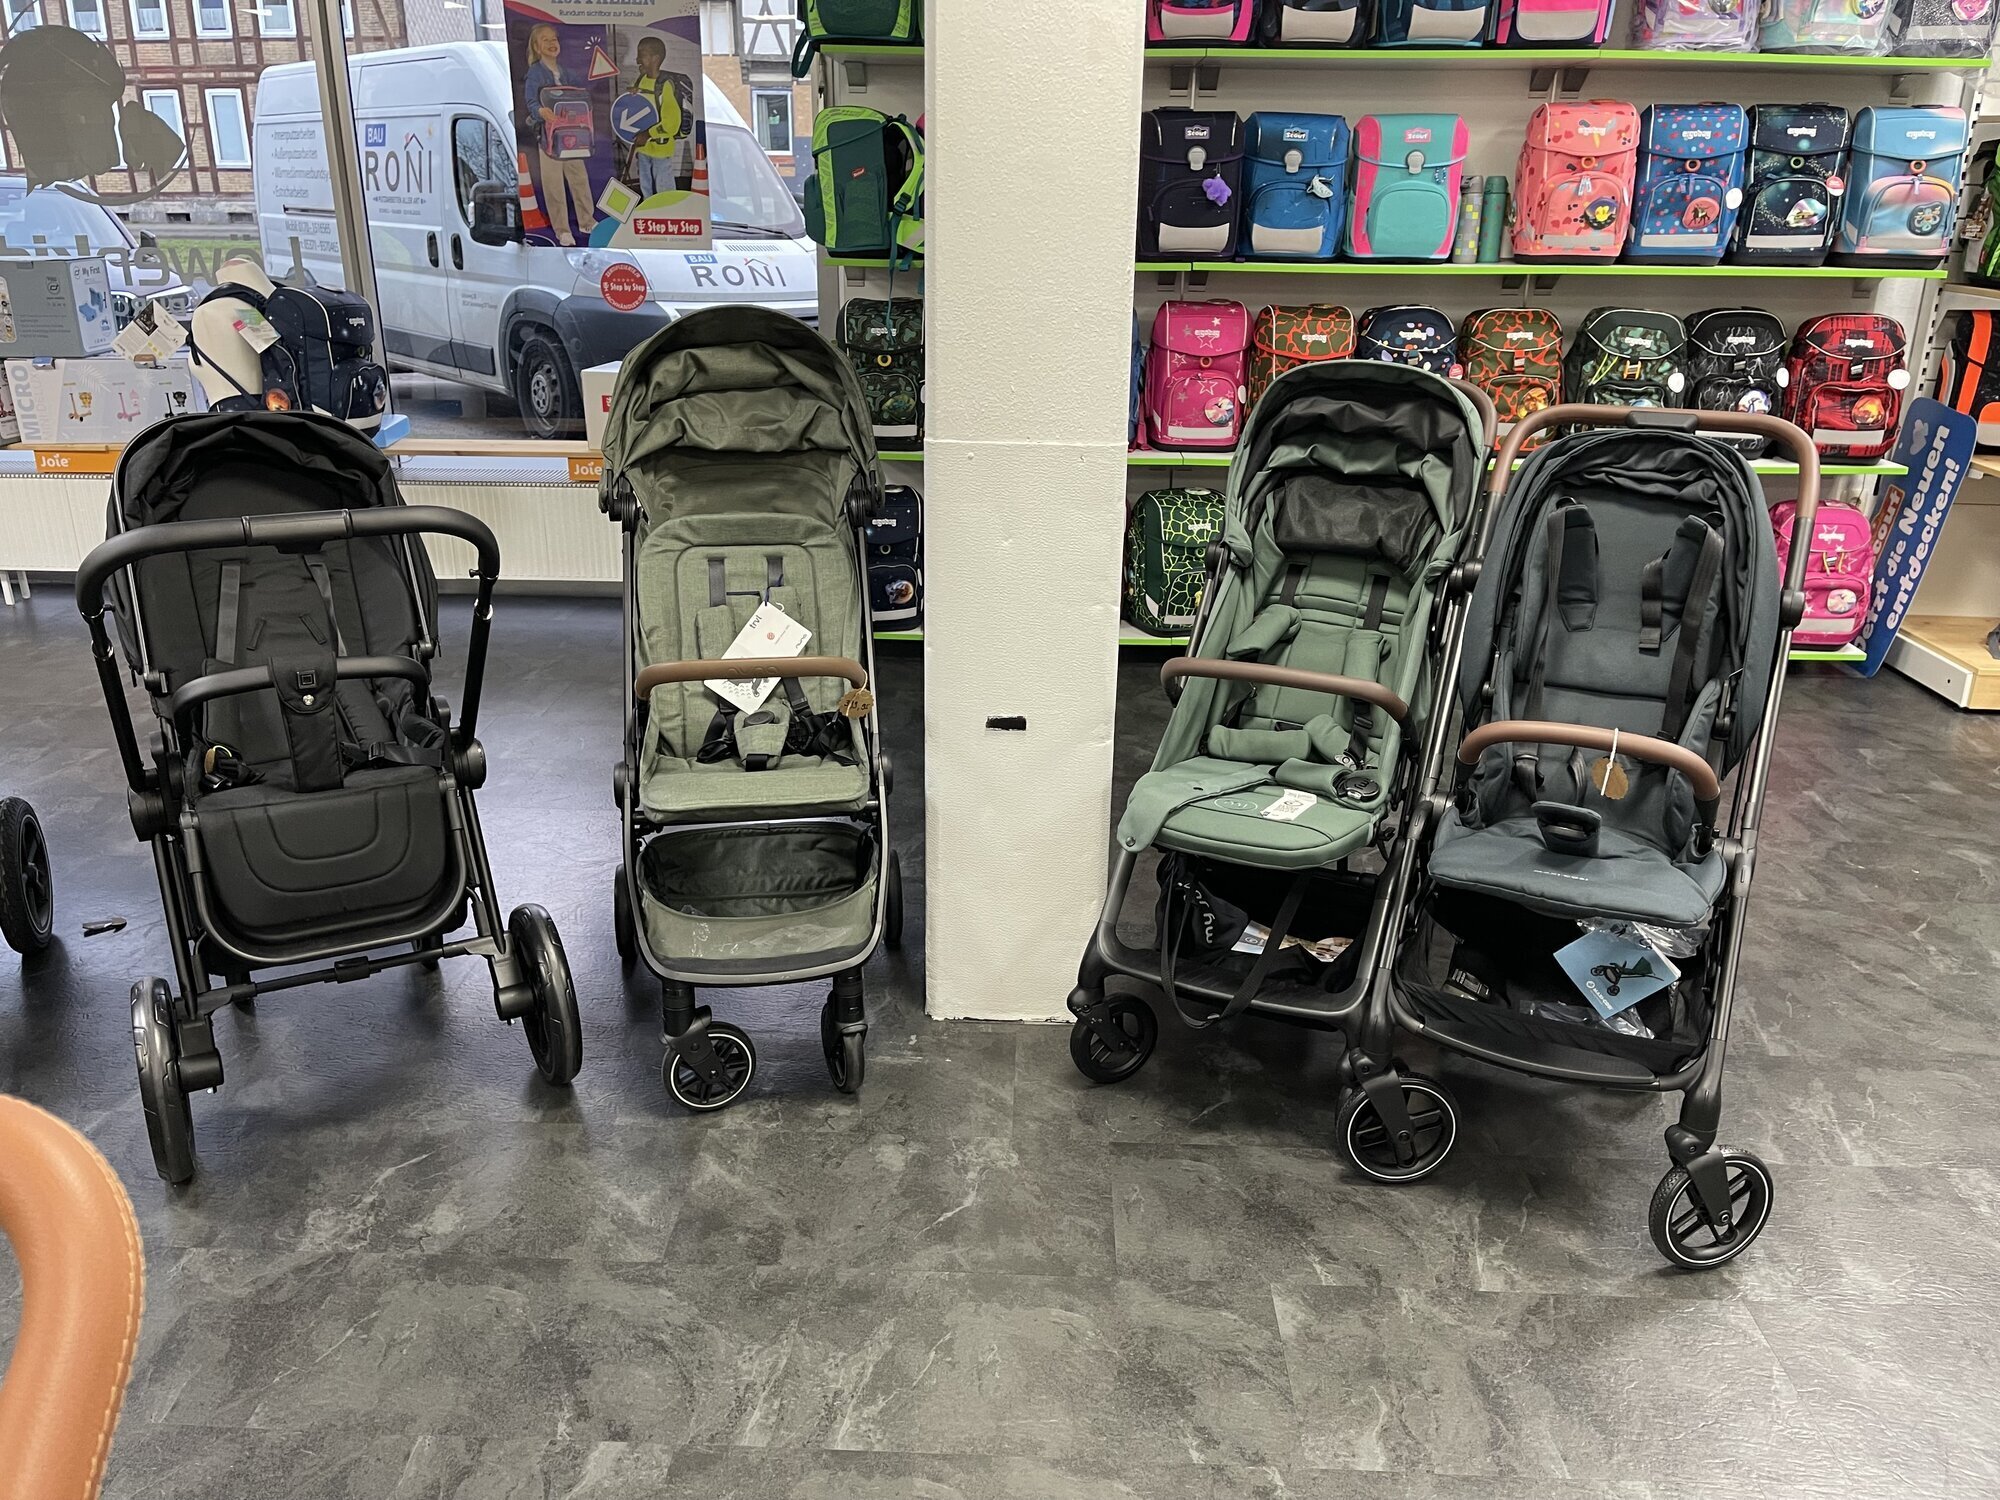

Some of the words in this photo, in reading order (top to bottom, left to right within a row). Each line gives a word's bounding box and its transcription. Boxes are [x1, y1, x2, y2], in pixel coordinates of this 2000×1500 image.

[367, 127, 384, 144] BAU
[365, 150, 433, 194] RONI
[647, 220, 667, 233] Step
[668, 219, 679, 234] by
[681, 220, 700, 235] Step
[689, 254, 713, 264] BAU
[690, 265, 788, 287] RONI
[610, 282, 624, 292] Step
[624, 282, 632, 293] by
[632, 282, 646, 293] Step
[11, 364, 42, 441] MICRO
[41, 453, 69, 468] Joie
[574, 462, 602, 475] Joie
[1887, 540, 1907, 577] die
[1899, 425, 1950, 536] Neuen
[1872, 490, 1901, 562] cout
[1887, 457, 1960, 630] entdecken!
